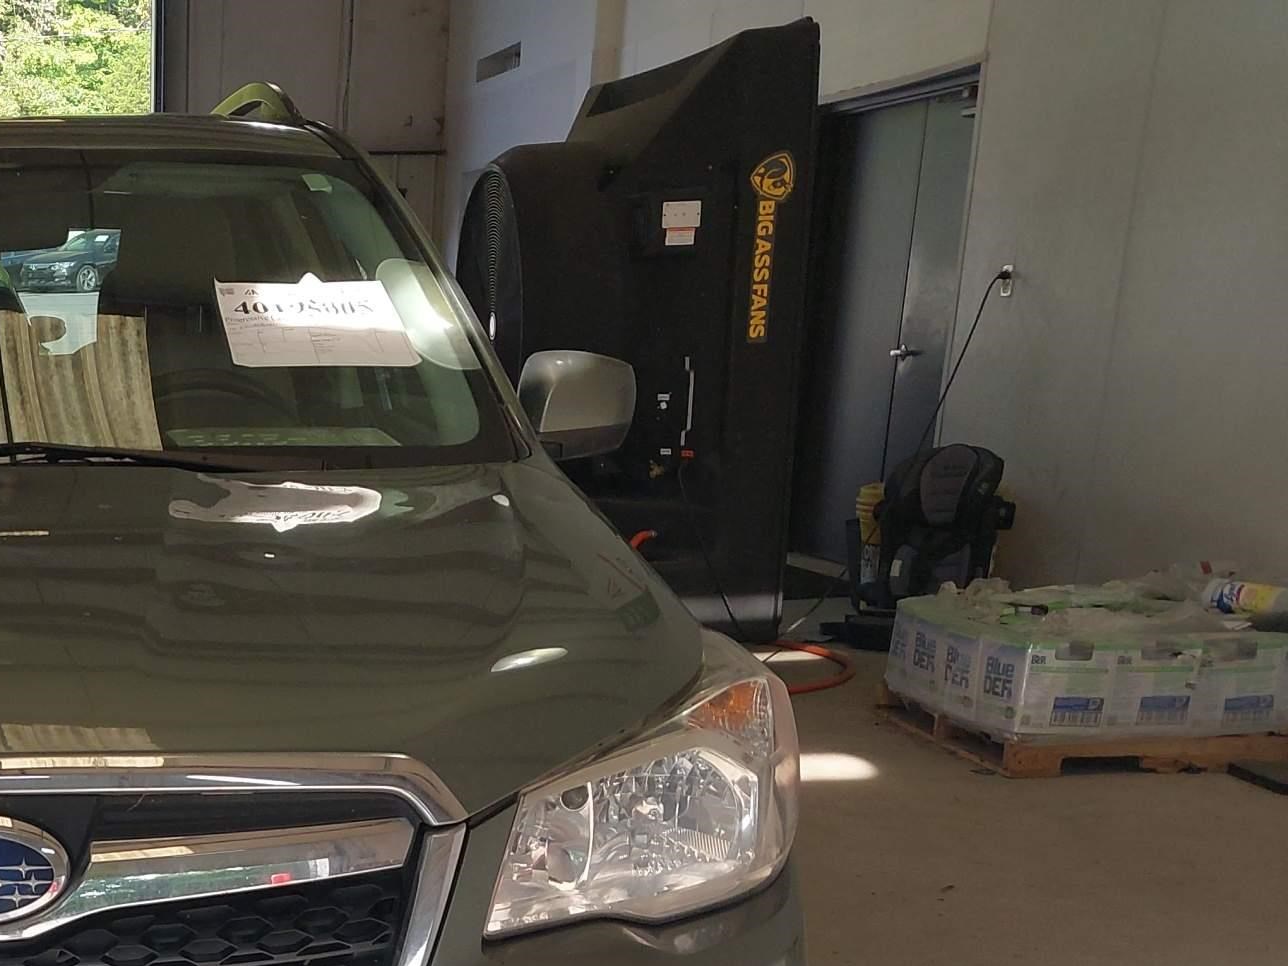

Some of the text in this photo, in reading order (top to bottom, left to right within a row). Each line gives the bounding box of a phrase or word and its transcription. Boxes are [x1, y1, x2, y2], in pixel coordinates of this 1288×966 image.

[749, 201, 775, 339] BIG ASS FANS
[985, 655, 1016, 678] Blue
[983, 675, 1013, 698] DEF
